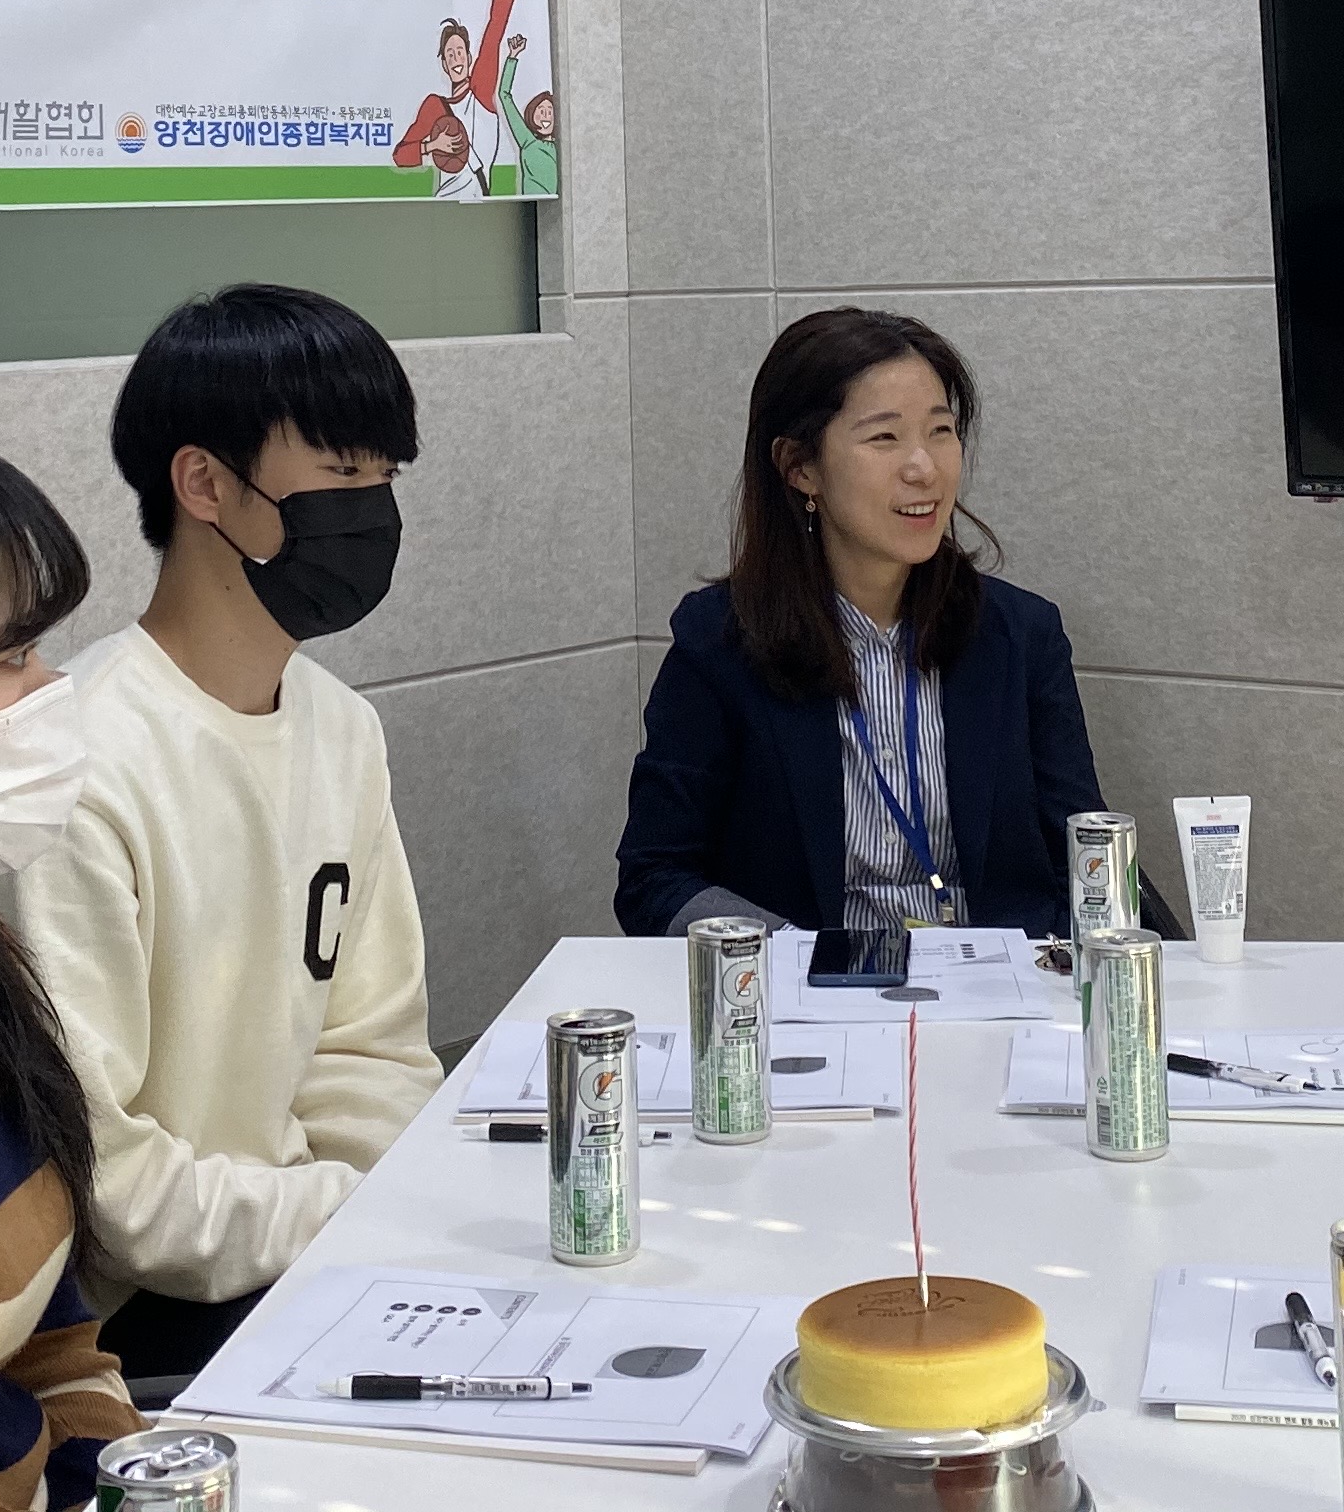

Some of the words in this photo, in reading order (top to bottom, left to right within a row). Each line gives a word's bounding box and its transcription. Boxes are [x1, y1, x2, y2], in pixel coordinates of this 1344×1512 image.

[60, 145, 104, 157] Korea
[154, 119, 394, 148] 양천장애인종합복지관
[304, 862, 350, 981] C
[578, 1057, 622, 1112] G
